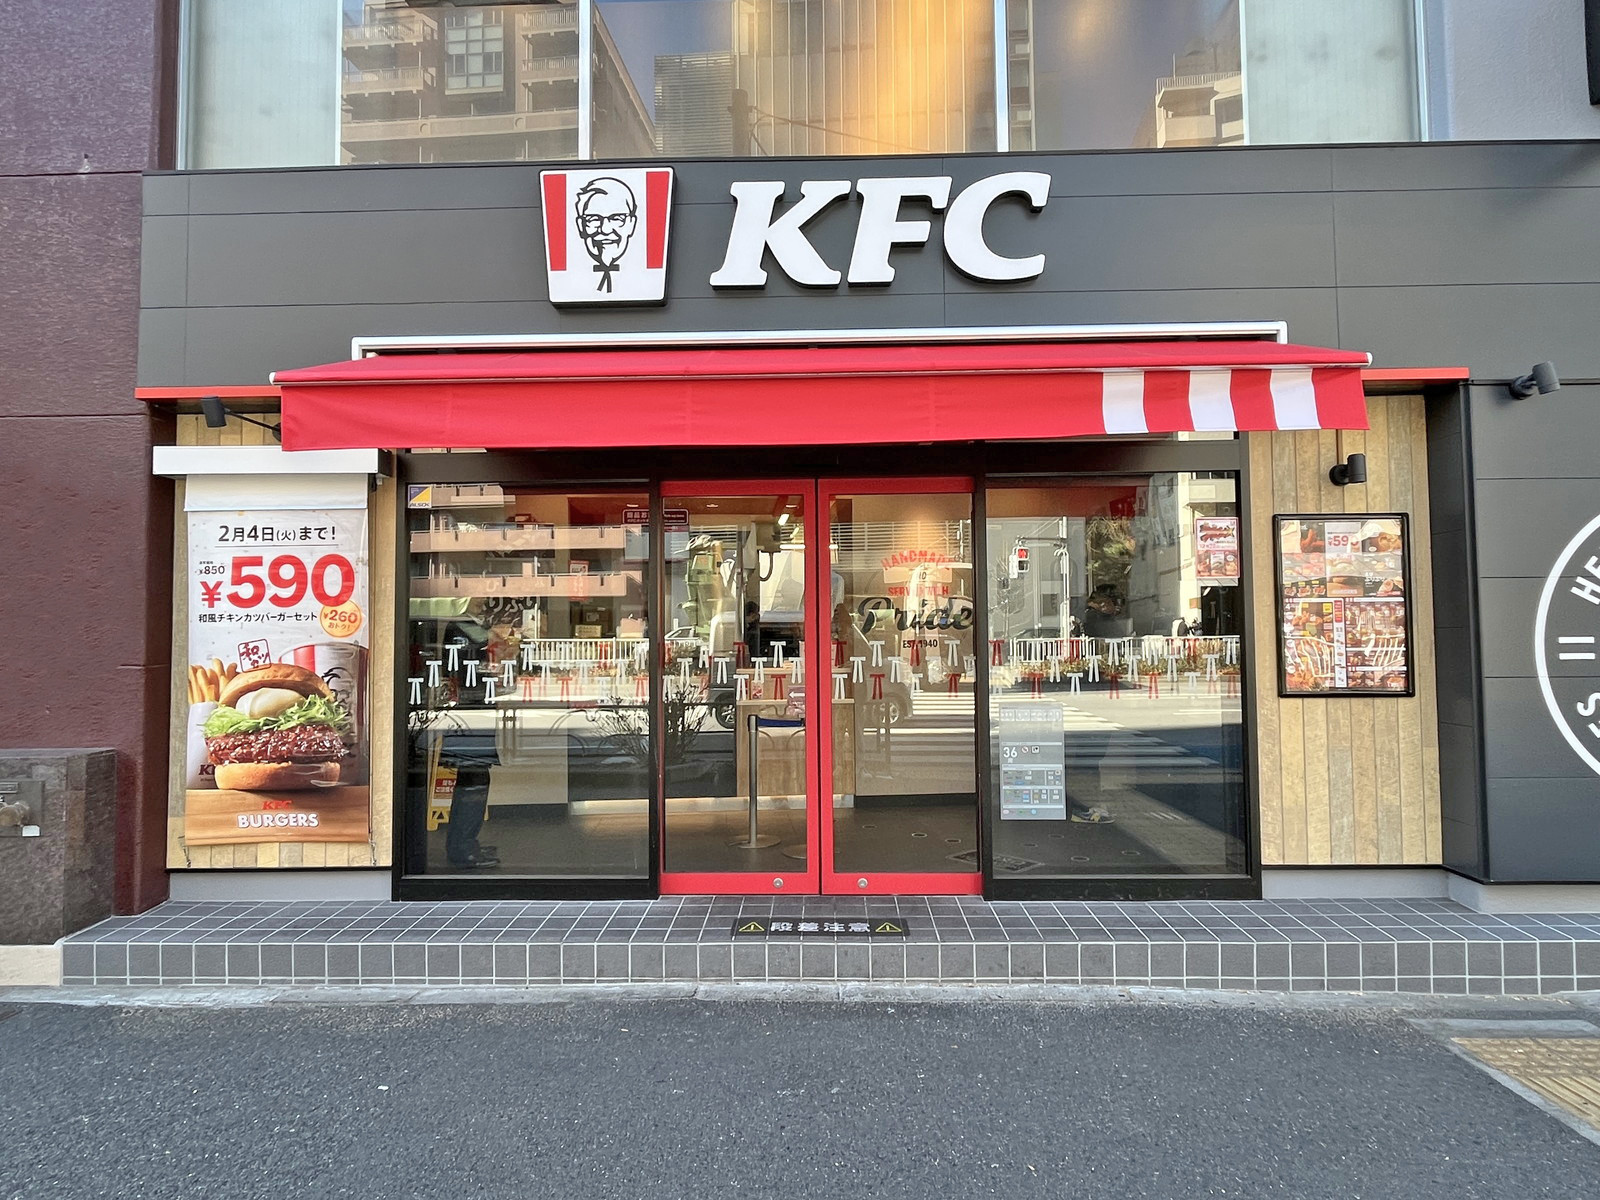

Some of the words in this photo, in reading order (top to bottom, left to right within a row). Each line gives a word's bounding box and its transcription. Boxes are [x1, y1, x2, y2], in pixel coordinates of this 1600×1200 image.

[709, 171, 1051, 289] KFC
[199, 553, 355, 609] ¥590
[198, 611, 318, 623] 和風チキンカツバーガーセット
[323, 609, 358, 623] ¥260
[858, 597, 973, 634] Pride
[1003, 746, 1018, 758] 36
[262, 800, 293, 811] KFC
[237, 813, 320, 828] BURGERS
[770, 922, 871, 932] 段差注意
